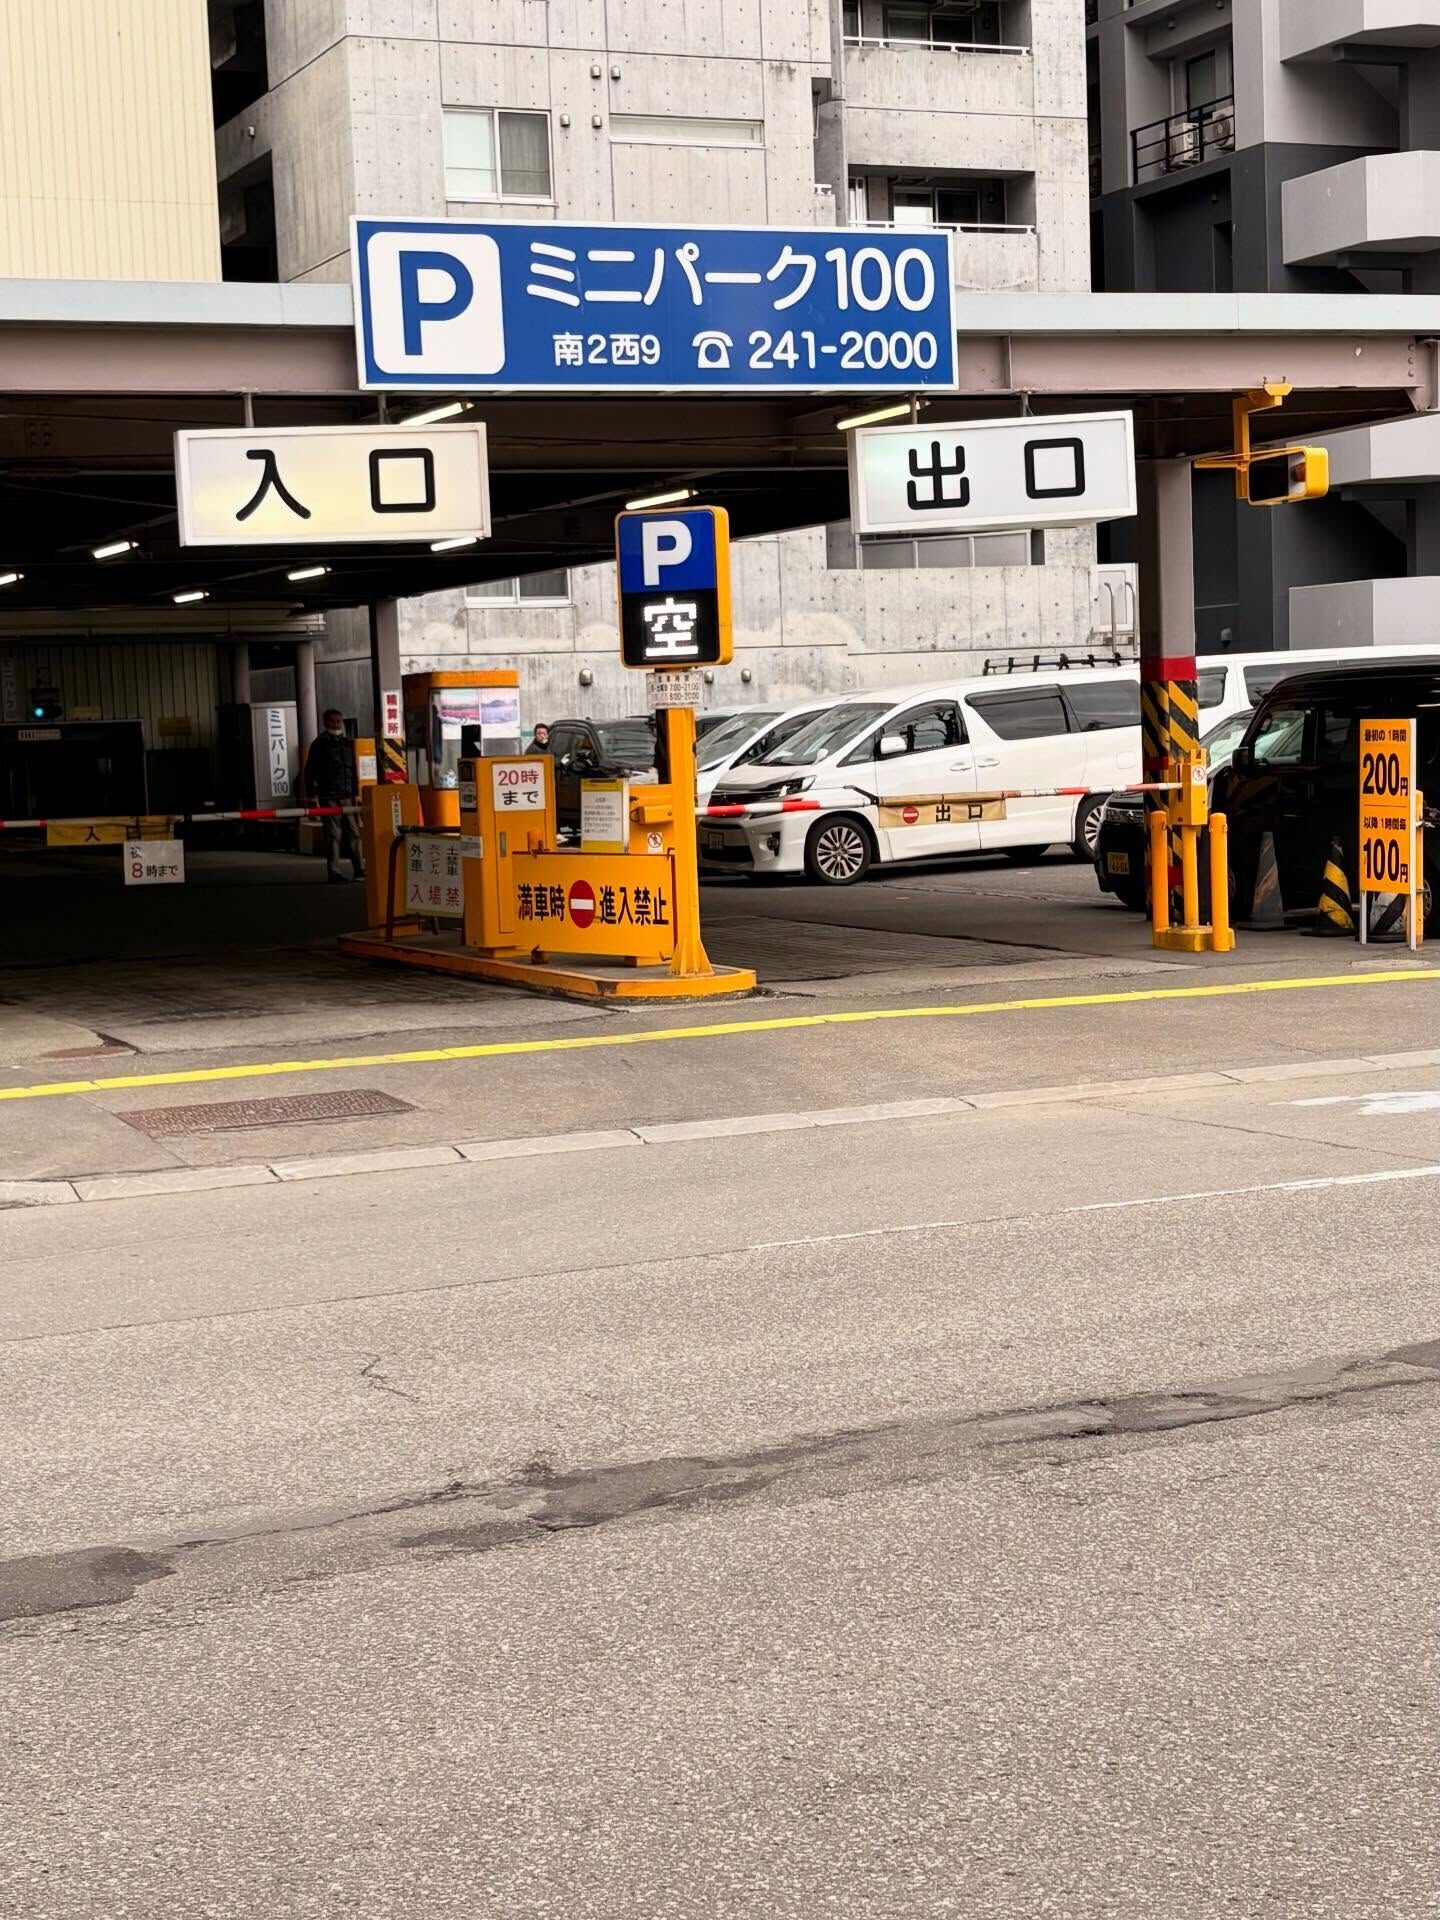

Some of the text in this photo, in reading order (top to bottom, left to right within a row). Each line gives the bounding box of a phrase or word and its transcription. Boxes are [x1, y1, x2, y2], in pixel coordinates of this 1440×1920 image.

[526, 241, 936, 312] ミニパーク100
[398, 249, 475, 356] P
[552, 330, 939, 370] 南2西9 241-2000
[235, 447, 437, 522] 入口
[906, 437, 1086, 511] 出口
[642, 520, 693, 587] P
[643, 597, 699, 657] 空
[498, 769, 540, 786] 20時
[501, 789, 540, 806] まで
[1362, 752, 1409, 797] 200円
[935, 804, 983, 823] 出口
[1363, 838, 1409, 884] 100円
[517, 883, 670, 926] 満車時 進入禁止
